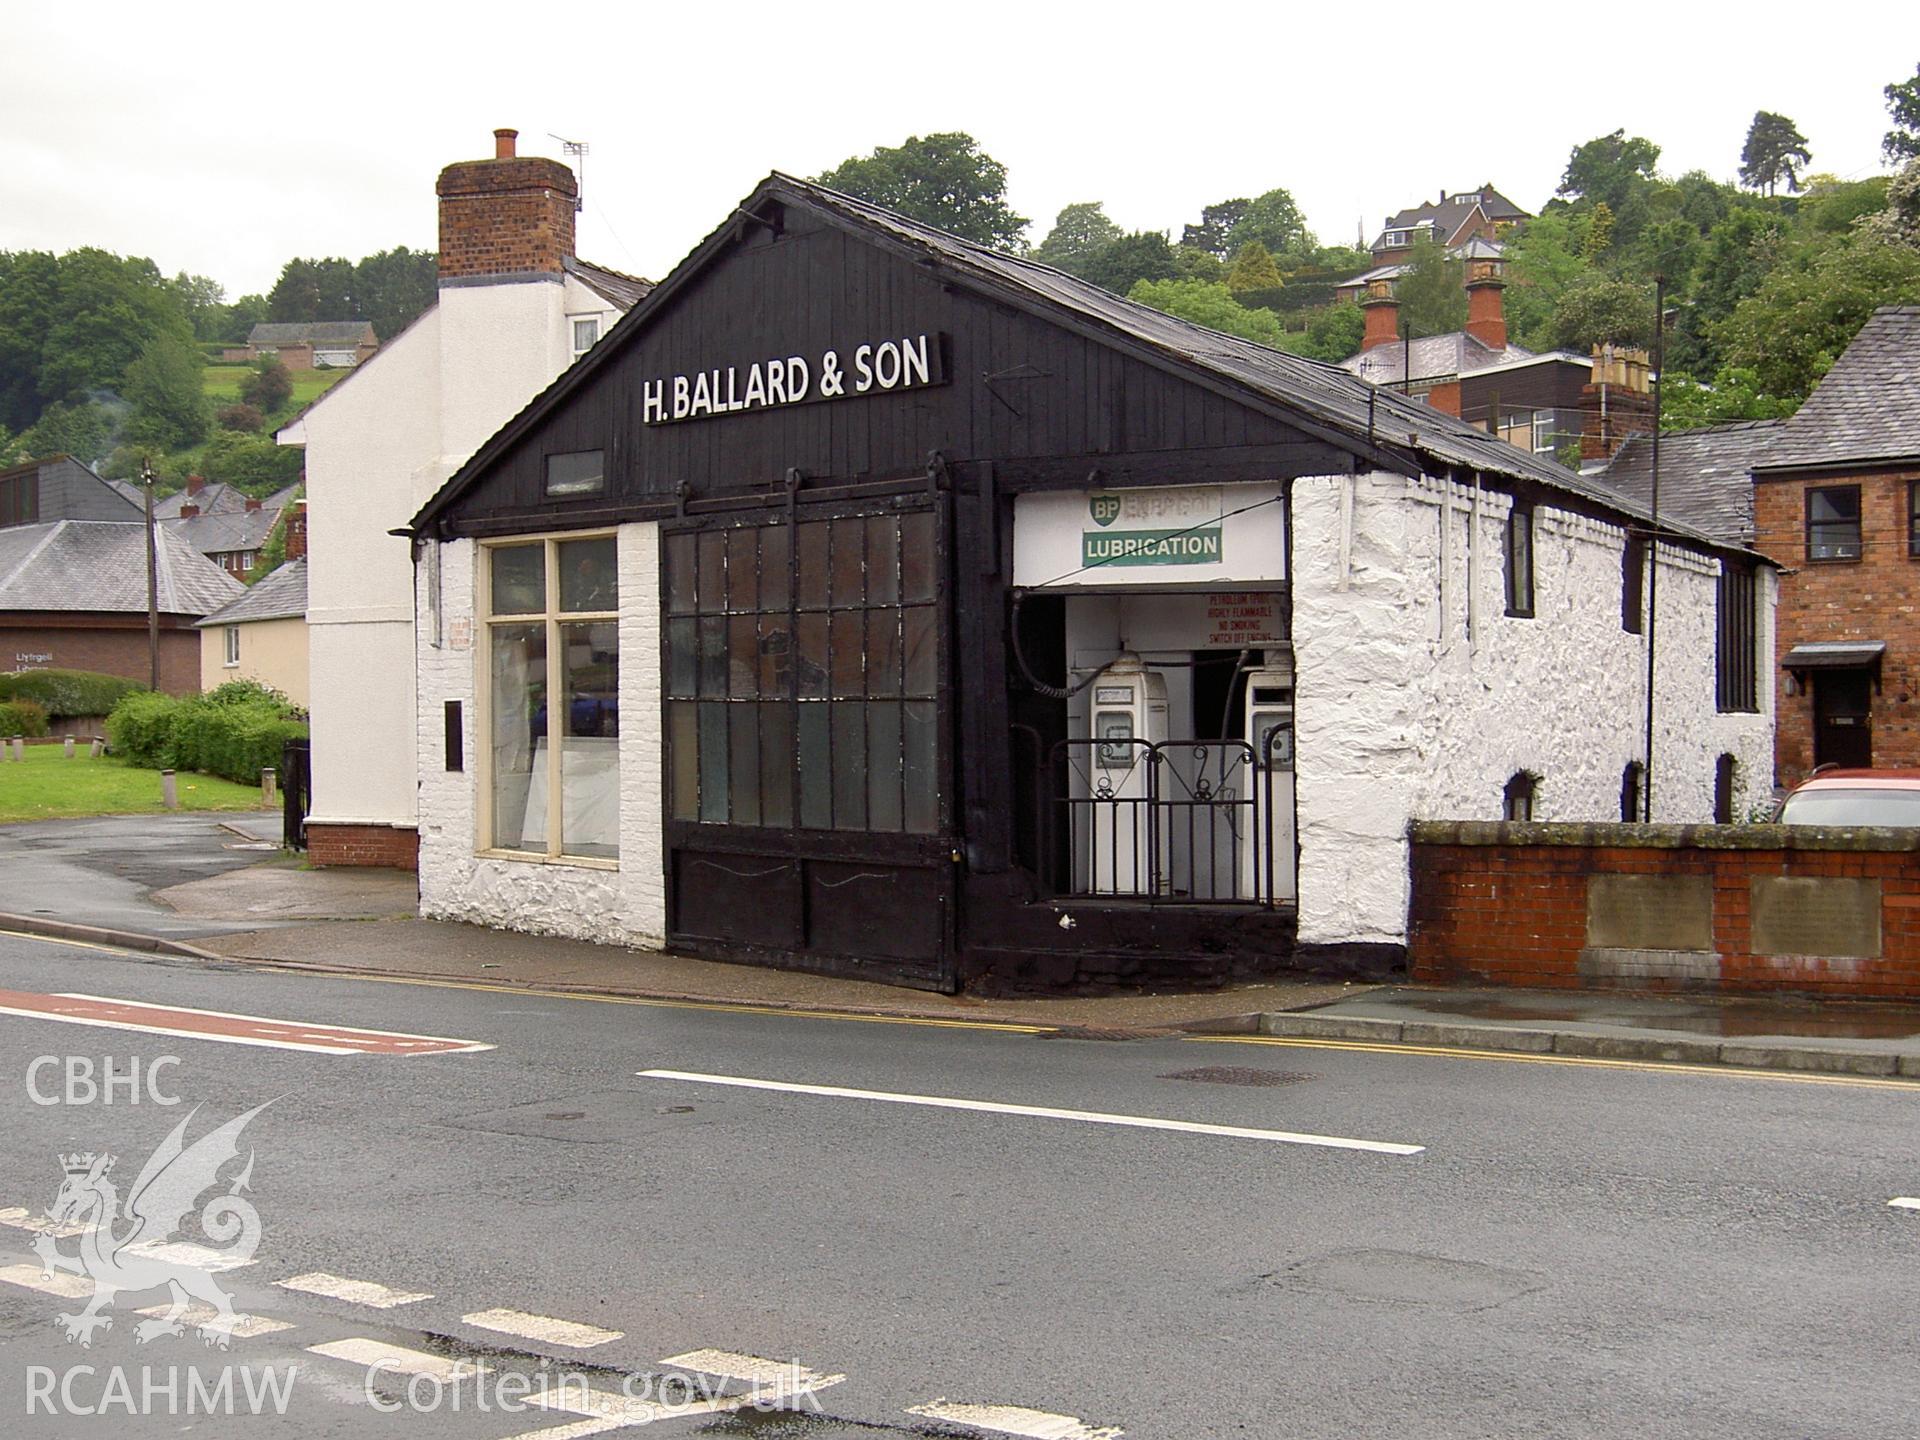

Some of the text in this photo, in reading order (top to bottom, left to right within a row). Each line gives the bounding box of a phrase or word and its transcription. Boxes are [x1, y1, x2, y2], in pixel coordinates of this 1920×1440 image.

[643, 335, 930, 422] H. BALLARD & SON
[1095, 501, 1119, 519] BP
[1086, 535, 1218, 558] LUBRICATION
[1230, 620, 1261, 631] SMOKING
